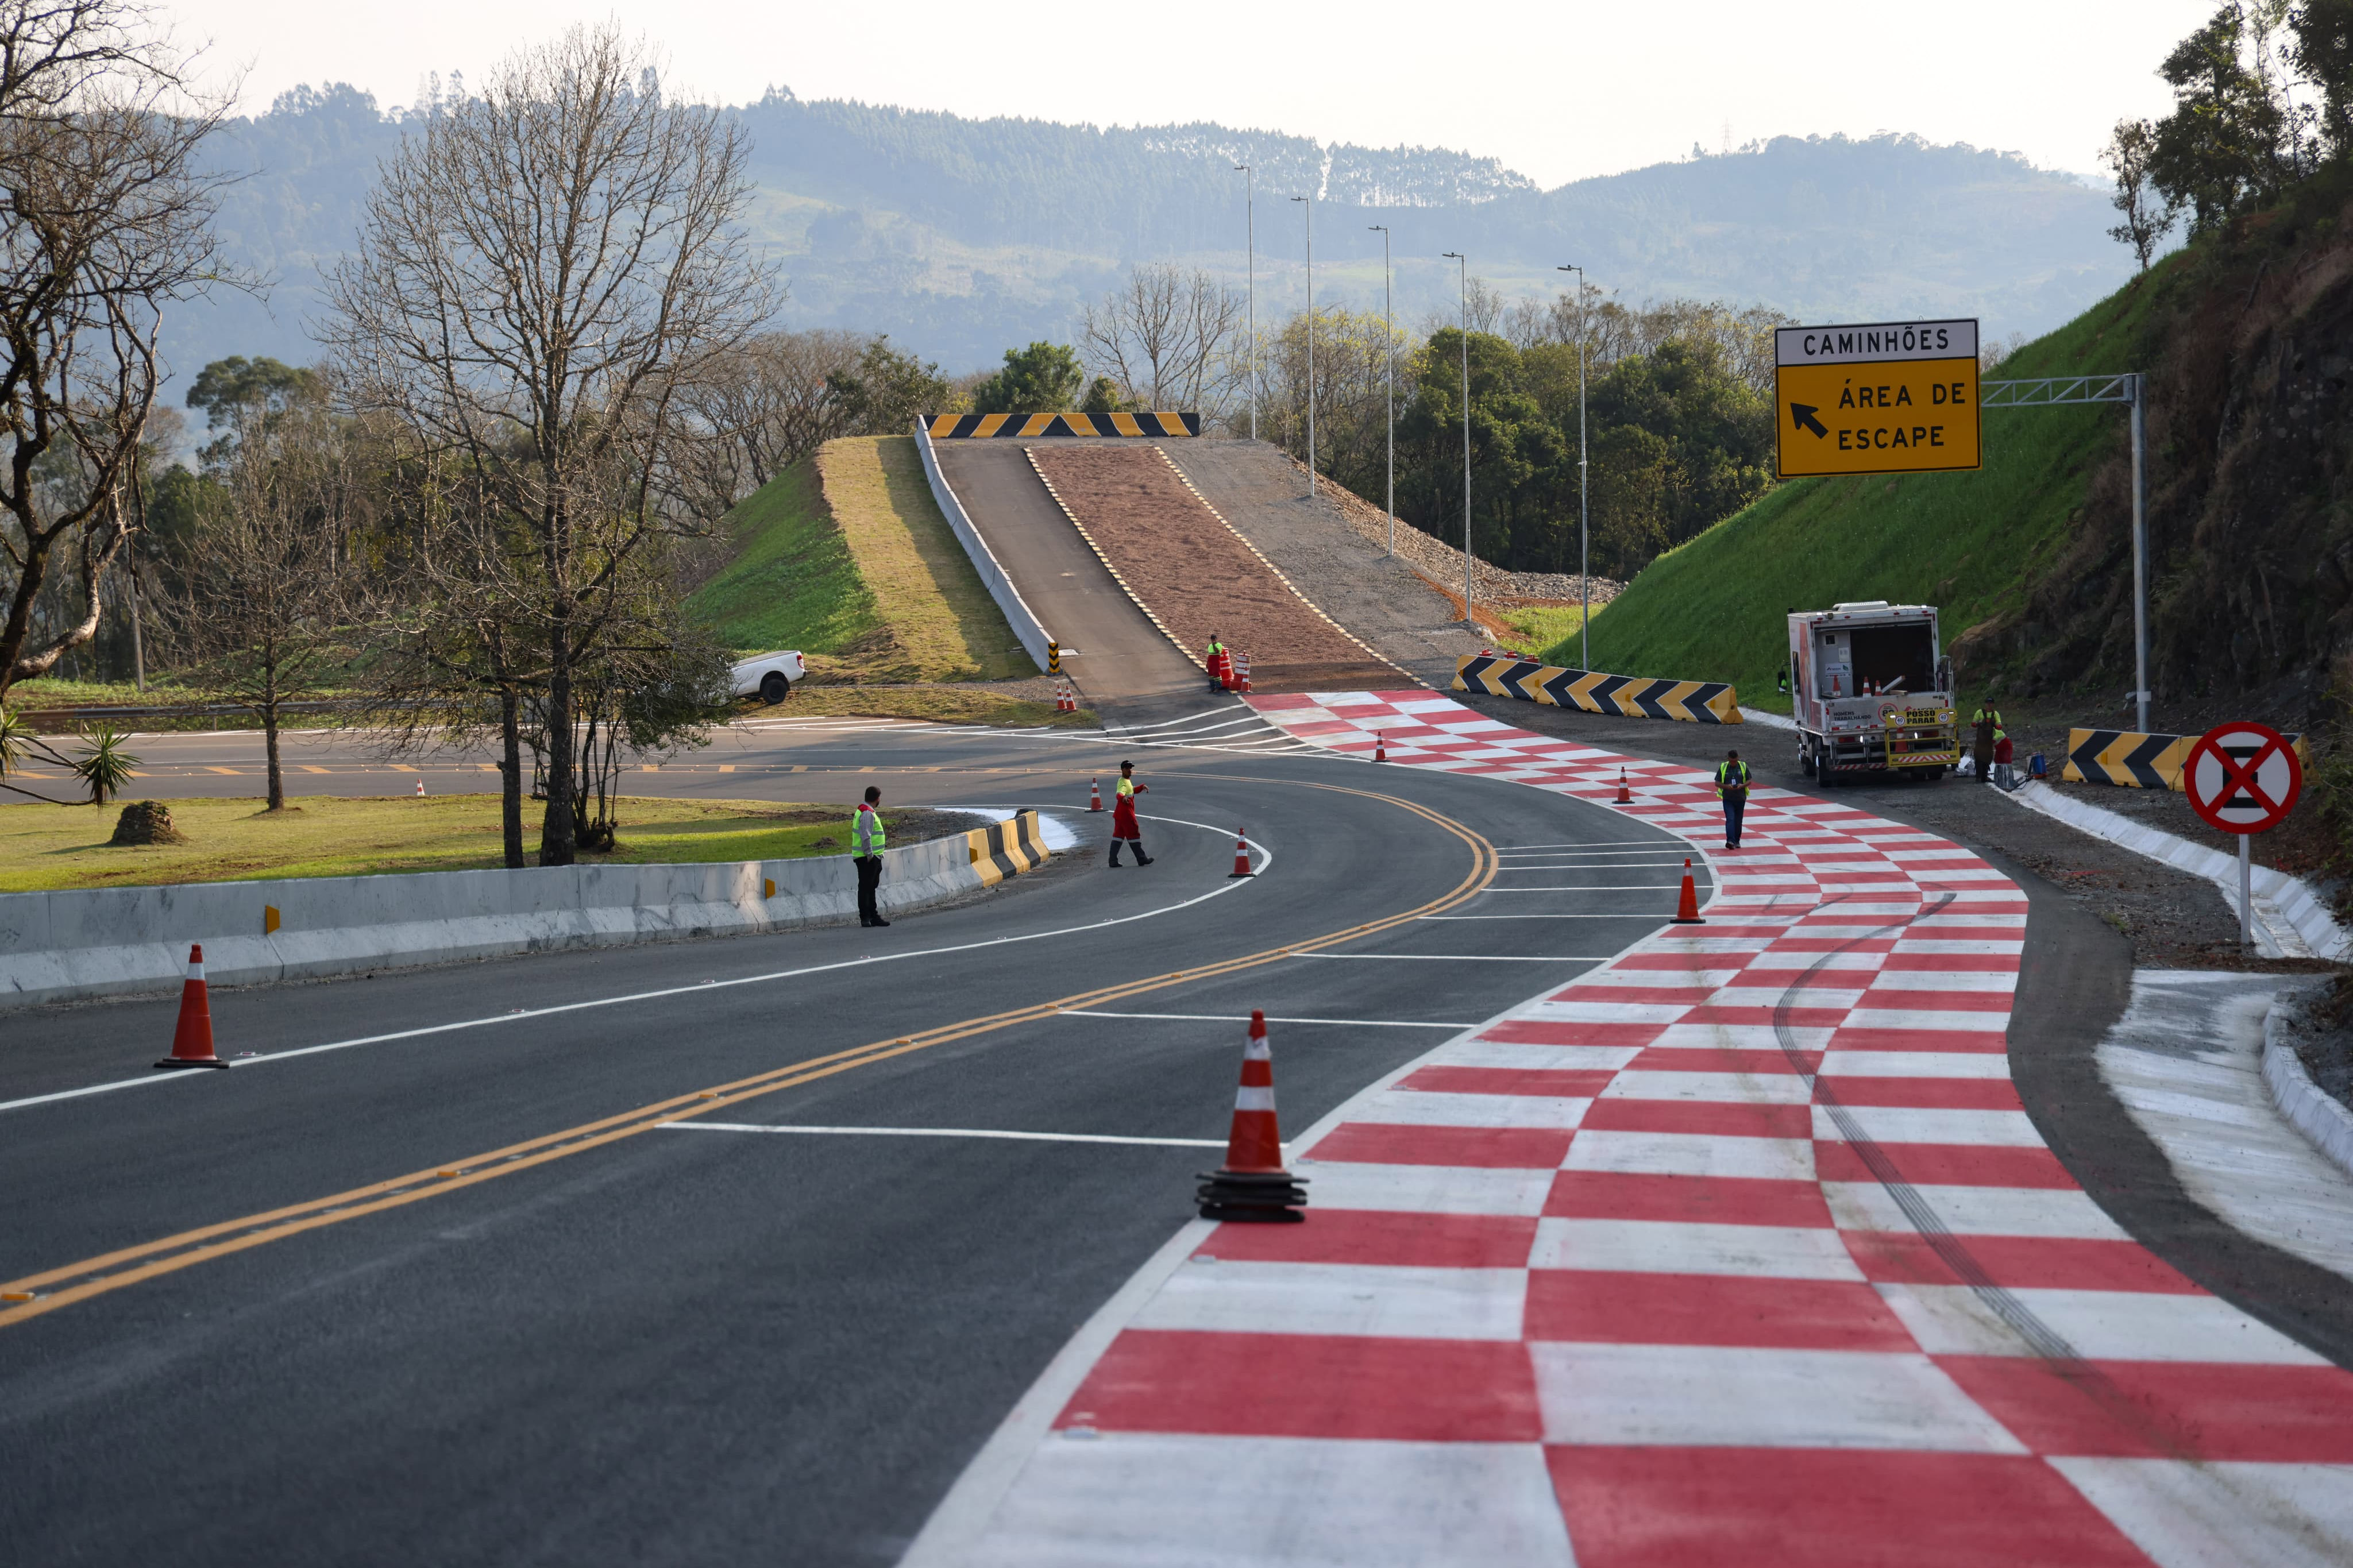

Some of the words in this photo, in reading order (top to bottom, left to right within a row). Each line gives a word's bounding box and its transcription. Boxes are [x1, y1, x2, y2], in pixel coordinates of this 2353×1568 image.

[1804, 326, 1949, 355] CAMINHÕES
[1839, 379, 1912, 408] ÁREA
[1932, 383, 1965, 404] DE
[1839, 426, 1944, 450] ESCAPE
